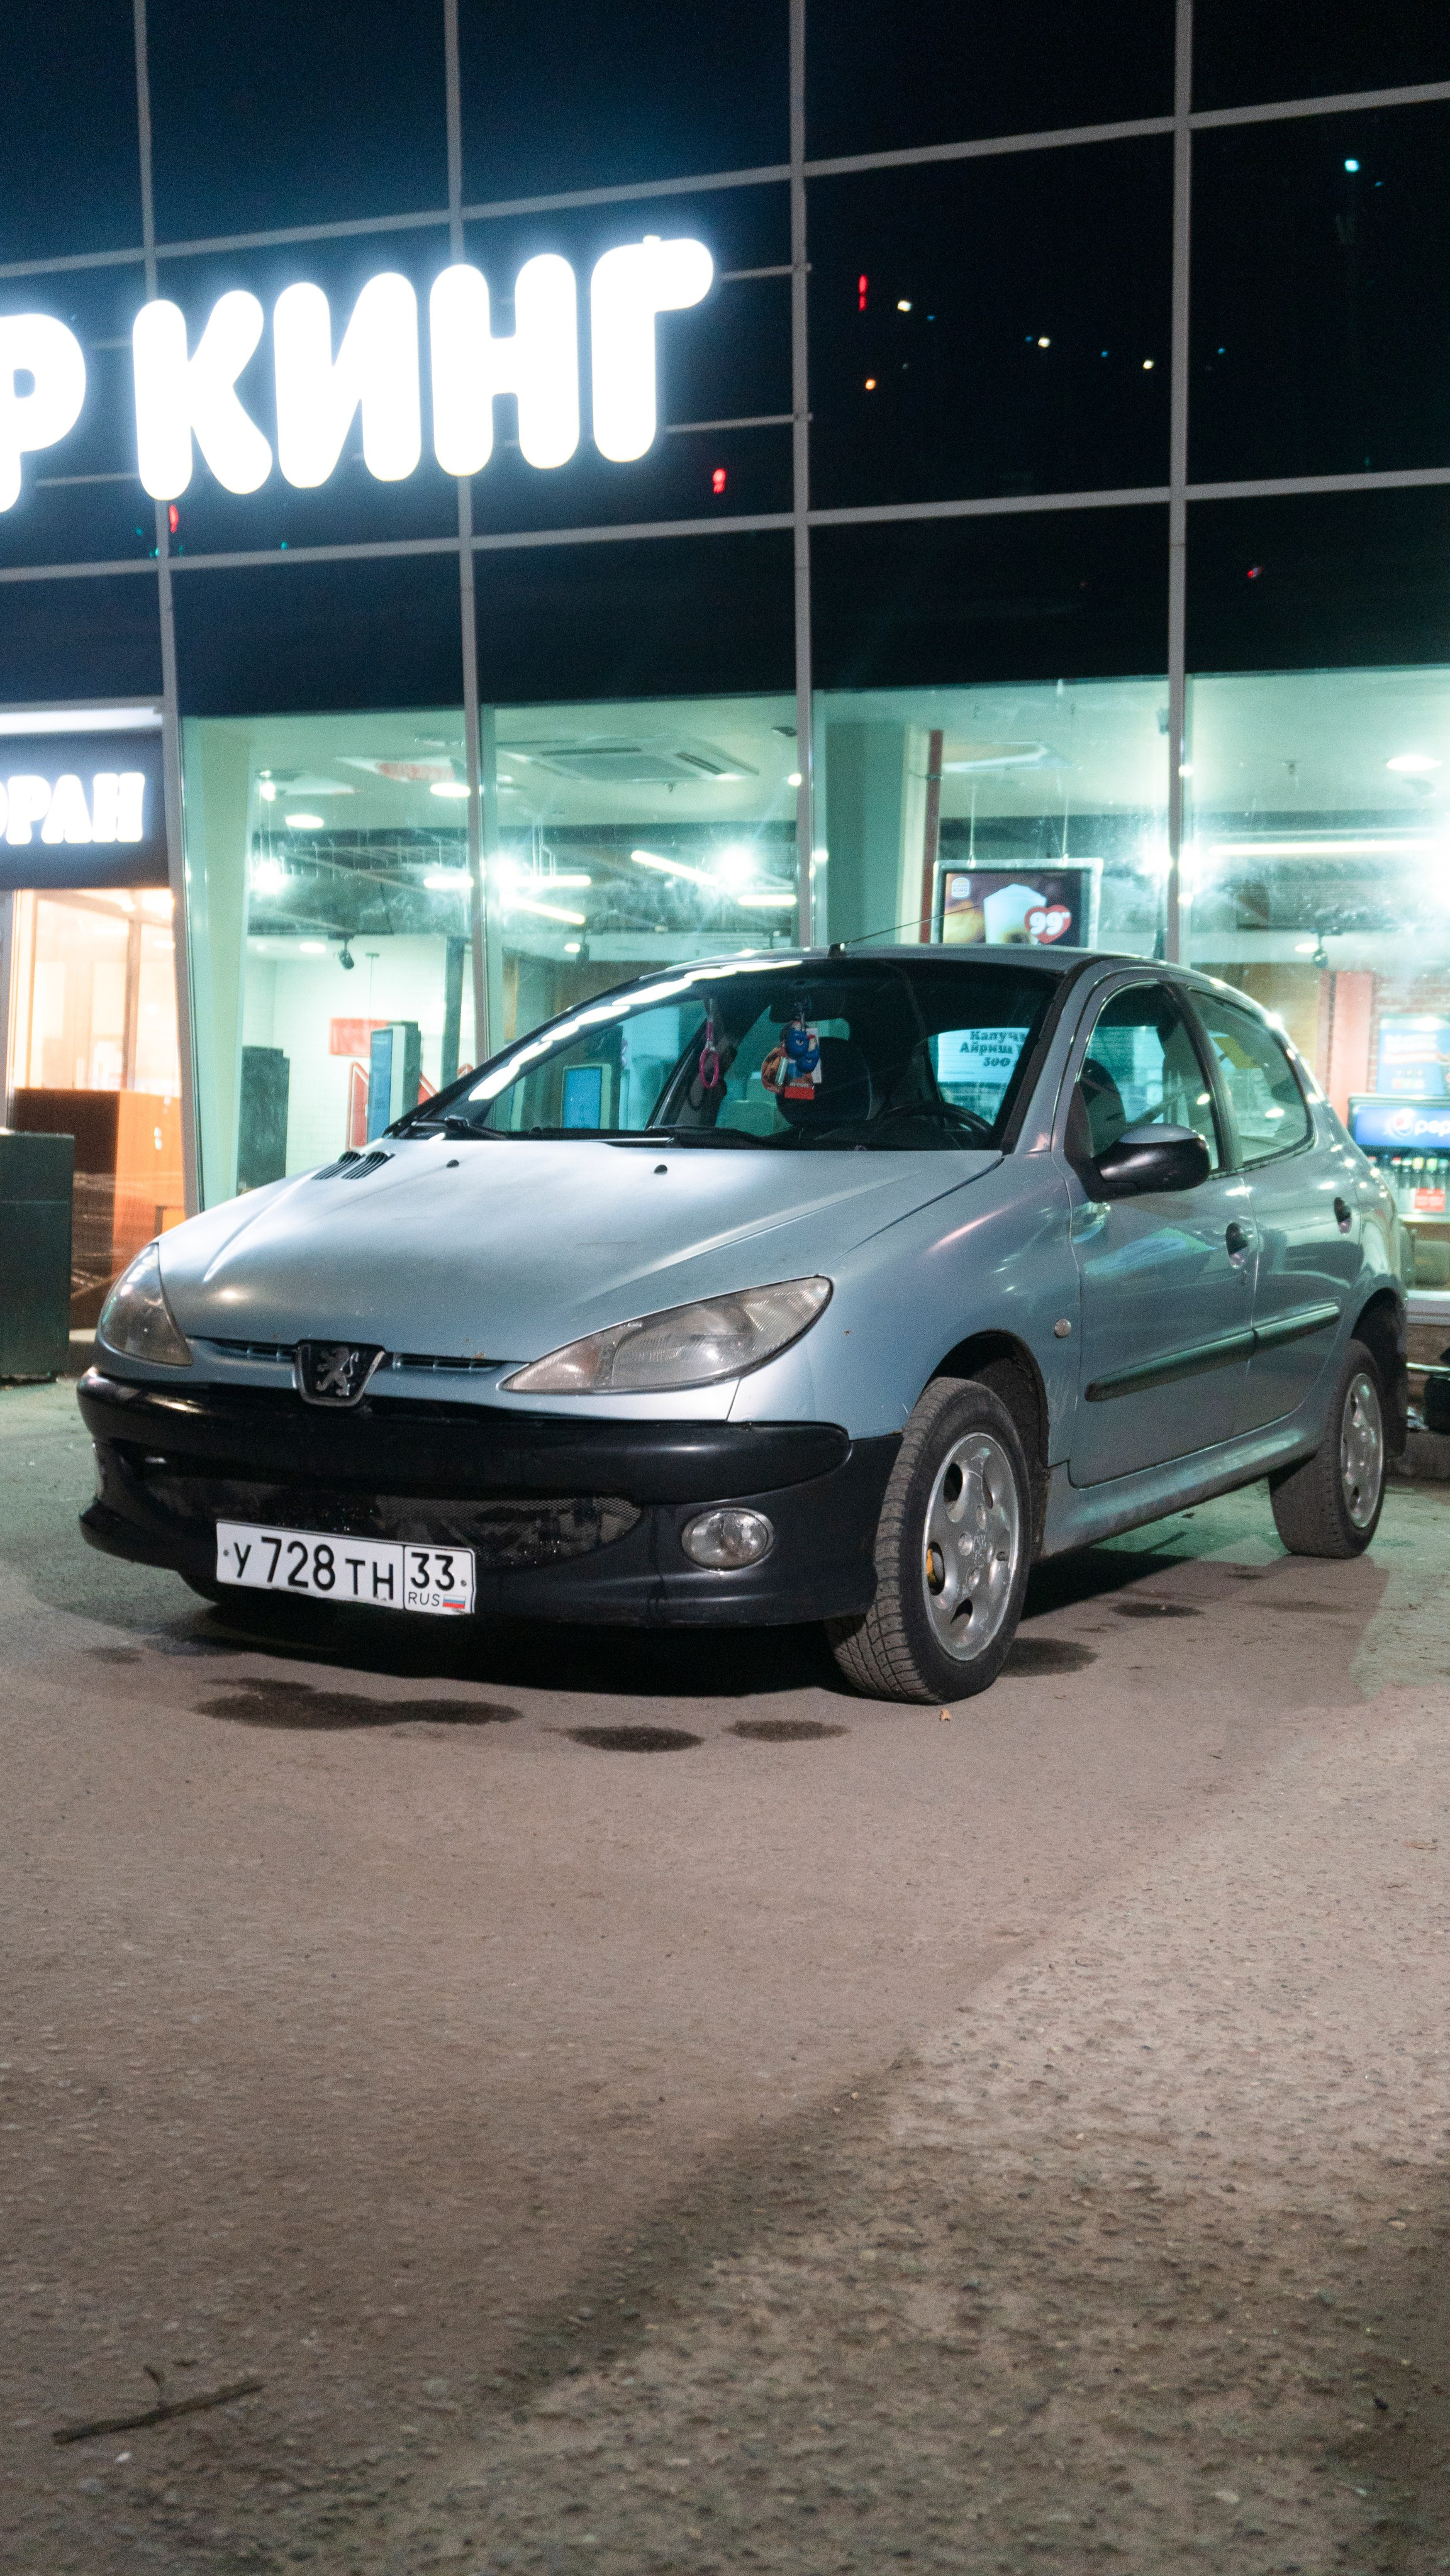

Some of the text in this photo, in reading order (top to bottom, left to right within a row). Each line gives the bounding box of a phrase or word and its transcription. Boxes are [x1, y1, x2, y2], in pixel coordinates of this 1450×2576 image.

[132, 235, 713, 501] КИНГ
[0, 772, 145, 845] РАН
[959, 1041, 1013, 1056] Айриш
[411, 1552, 455, 1591] 33
[408, 1592, 440, 1607] RUS
